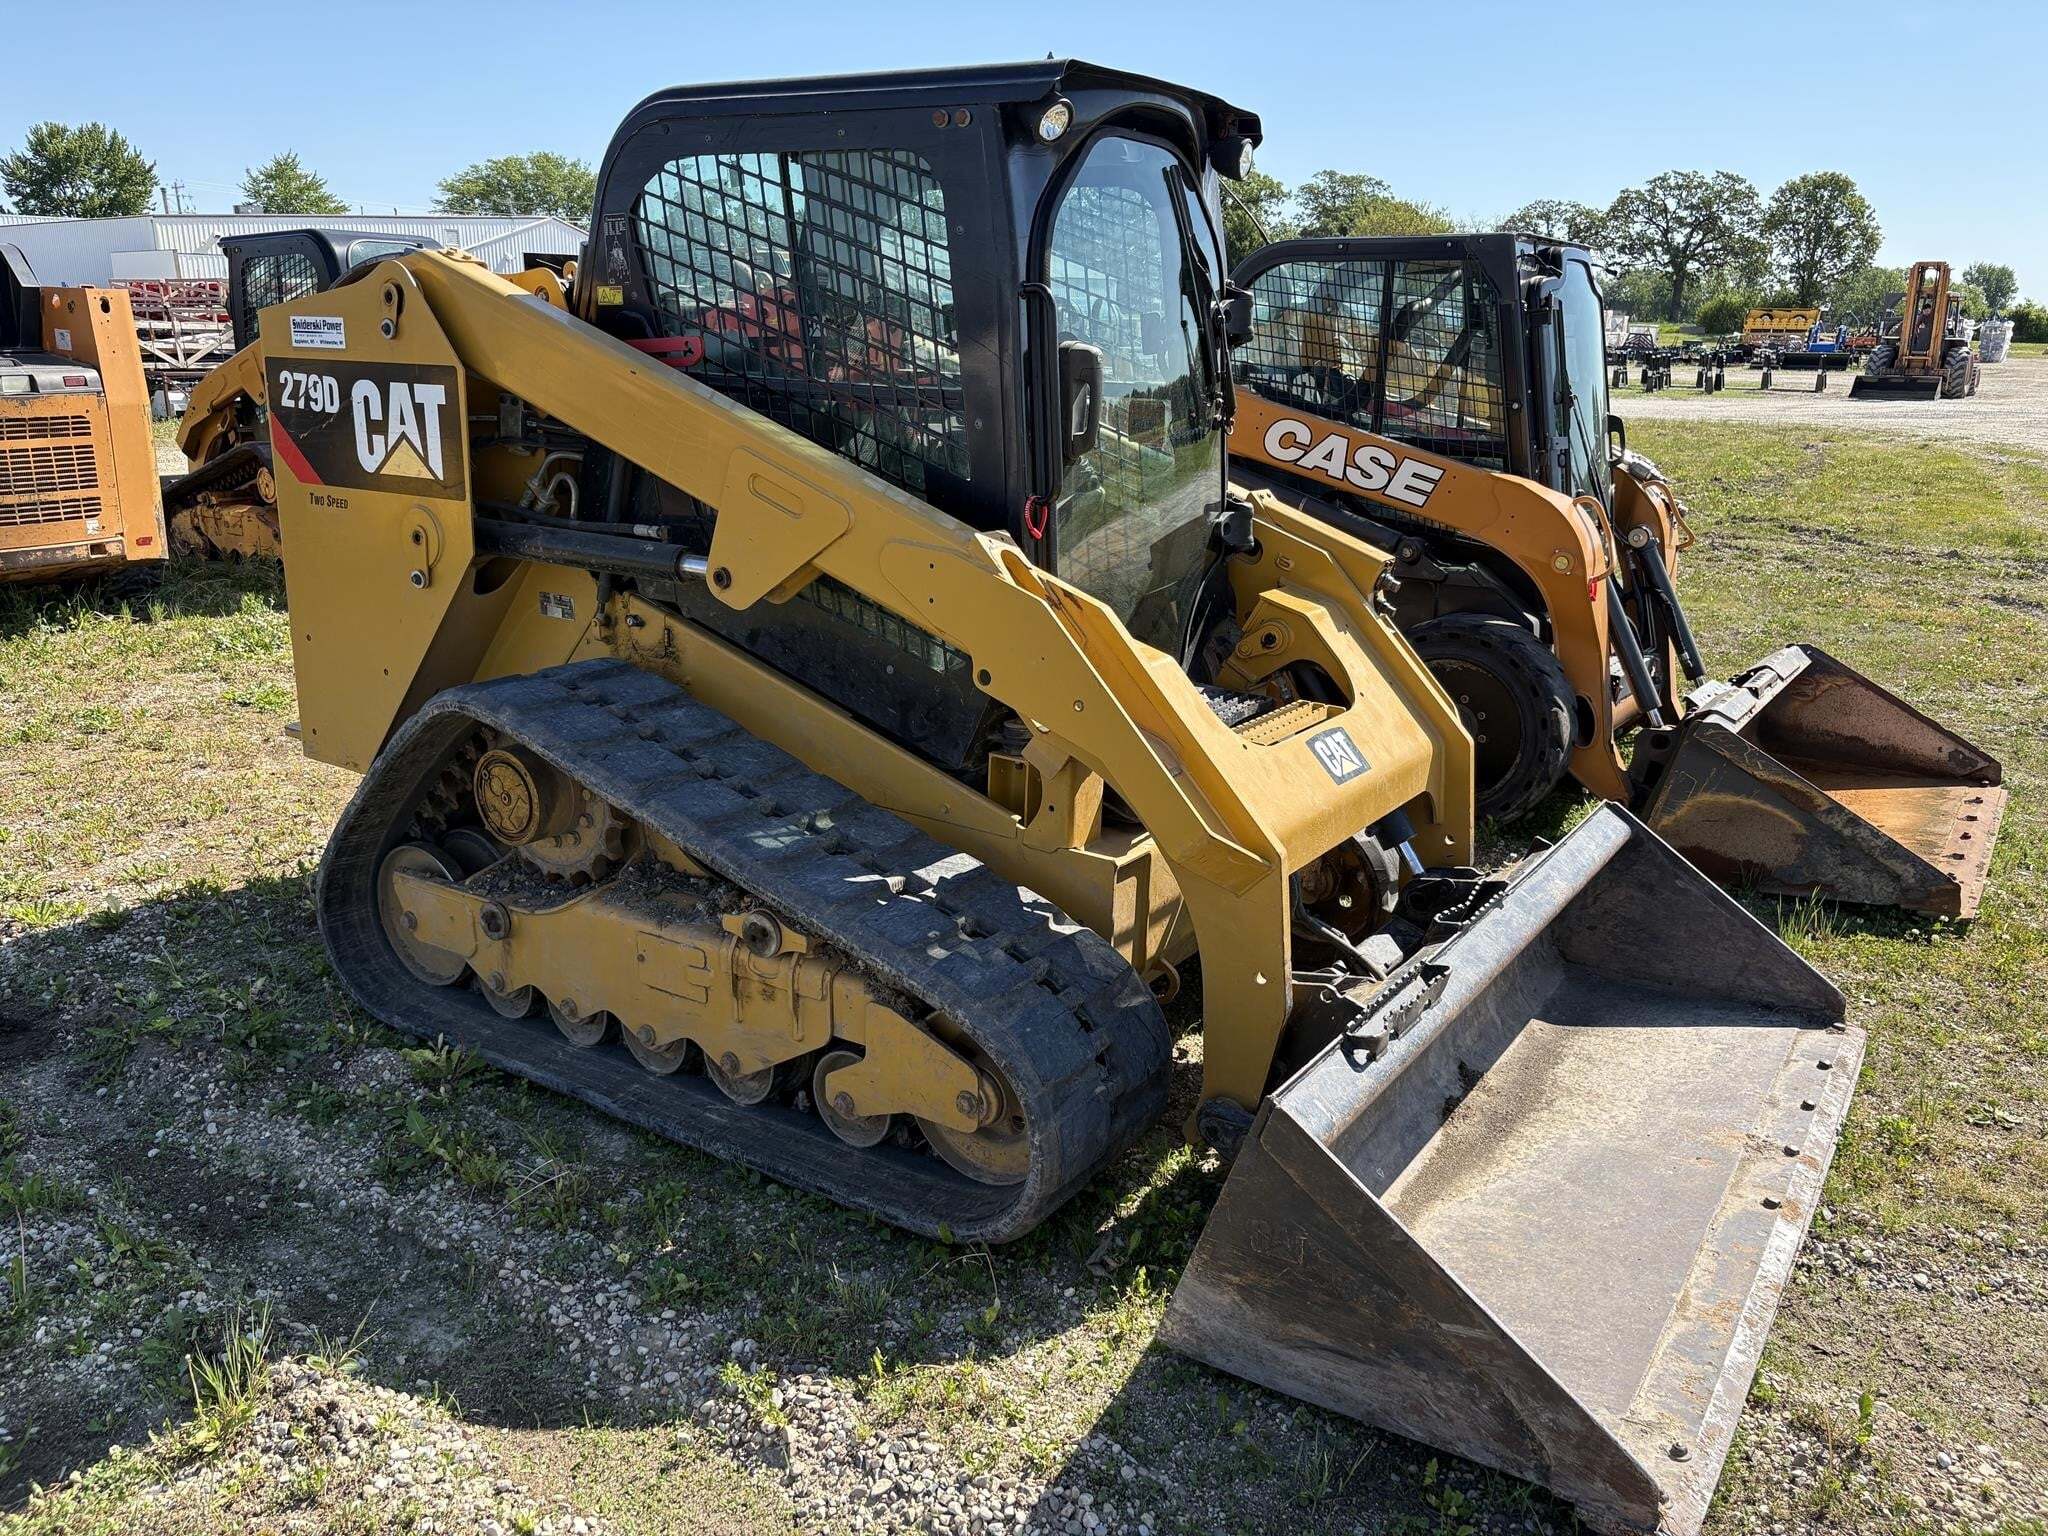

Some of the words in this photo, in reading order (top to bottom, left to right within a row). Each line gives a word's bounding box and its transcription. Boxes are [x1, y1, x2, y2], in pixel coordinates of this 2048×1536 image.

[292, 318, 322, 330] Swiderski
[322, 319, 342, 331] Power
[279, 370, 340, 414] 279D
[351, 379, 446, 481] CAT
[1263, 418, 1447, 508] CASE
[1314, 731, 1363, 778] CAT
